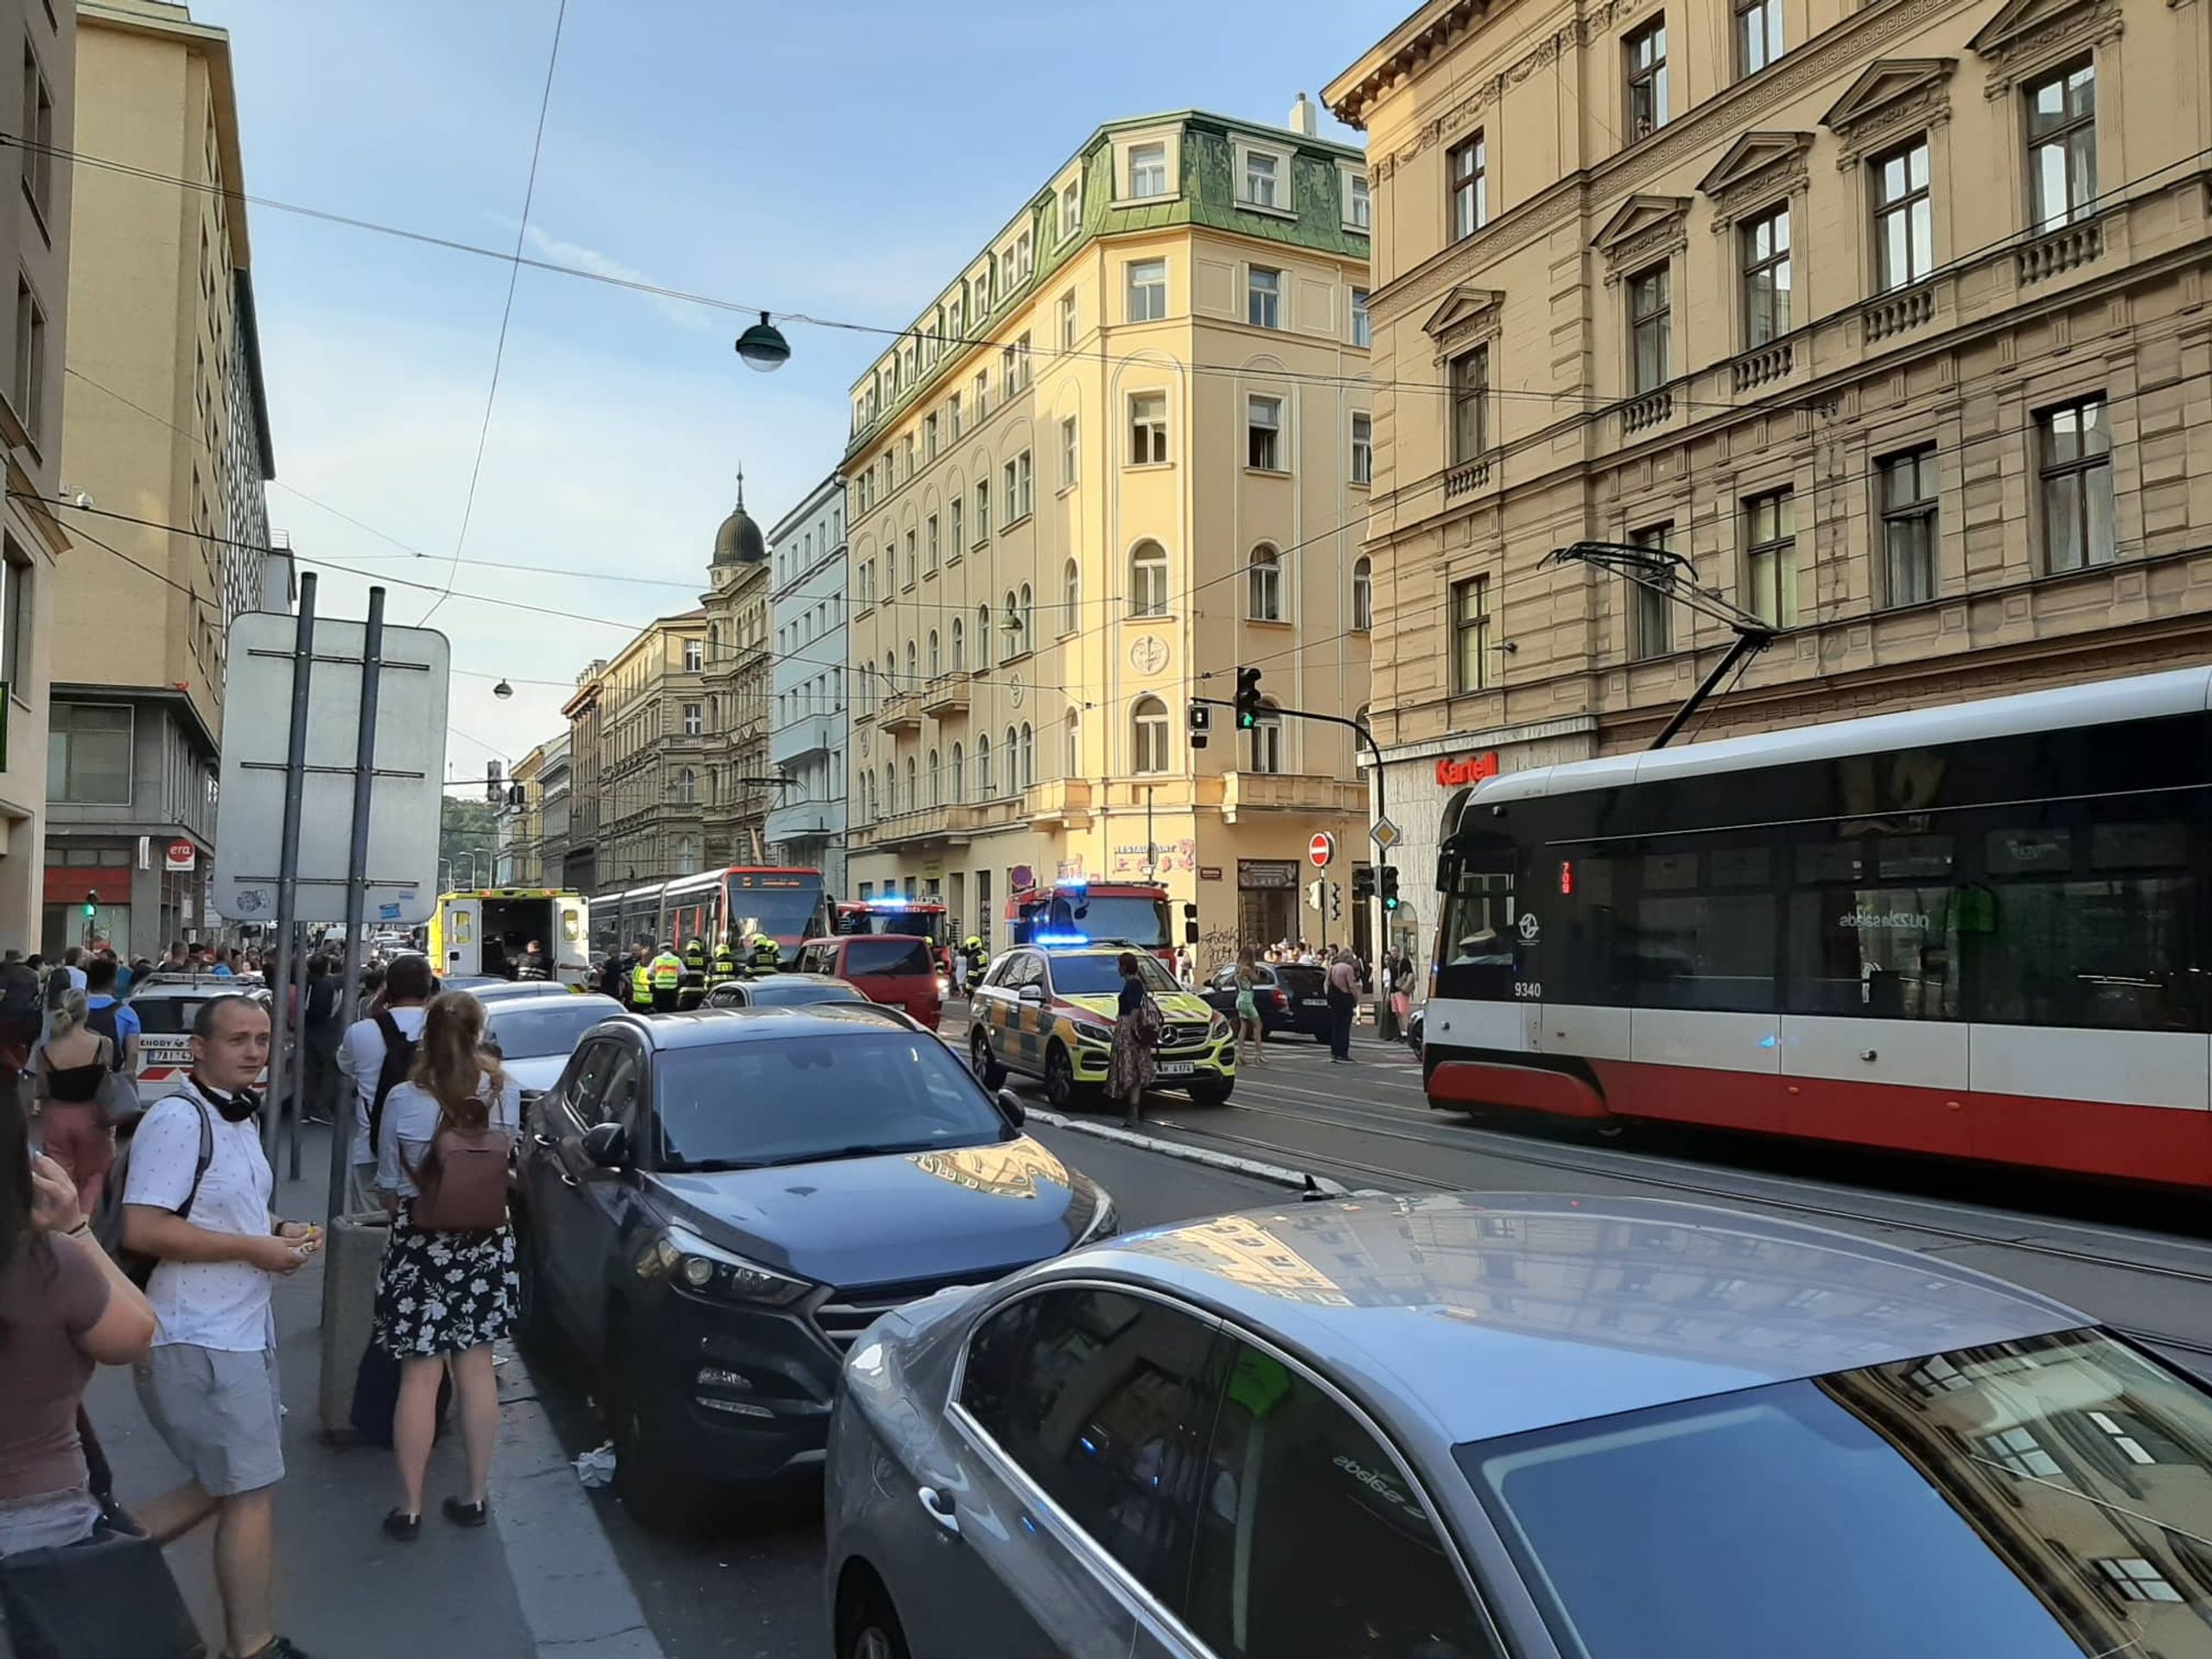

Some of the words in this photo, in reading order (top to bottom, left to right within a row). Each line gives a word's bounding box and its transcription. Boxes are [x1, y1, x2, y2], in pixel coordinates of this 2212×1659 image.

[1437, 752, 1498, 785] Kartell
[169, 845, 191, 855] era
[1515, 982, 1541, 997] 9340
